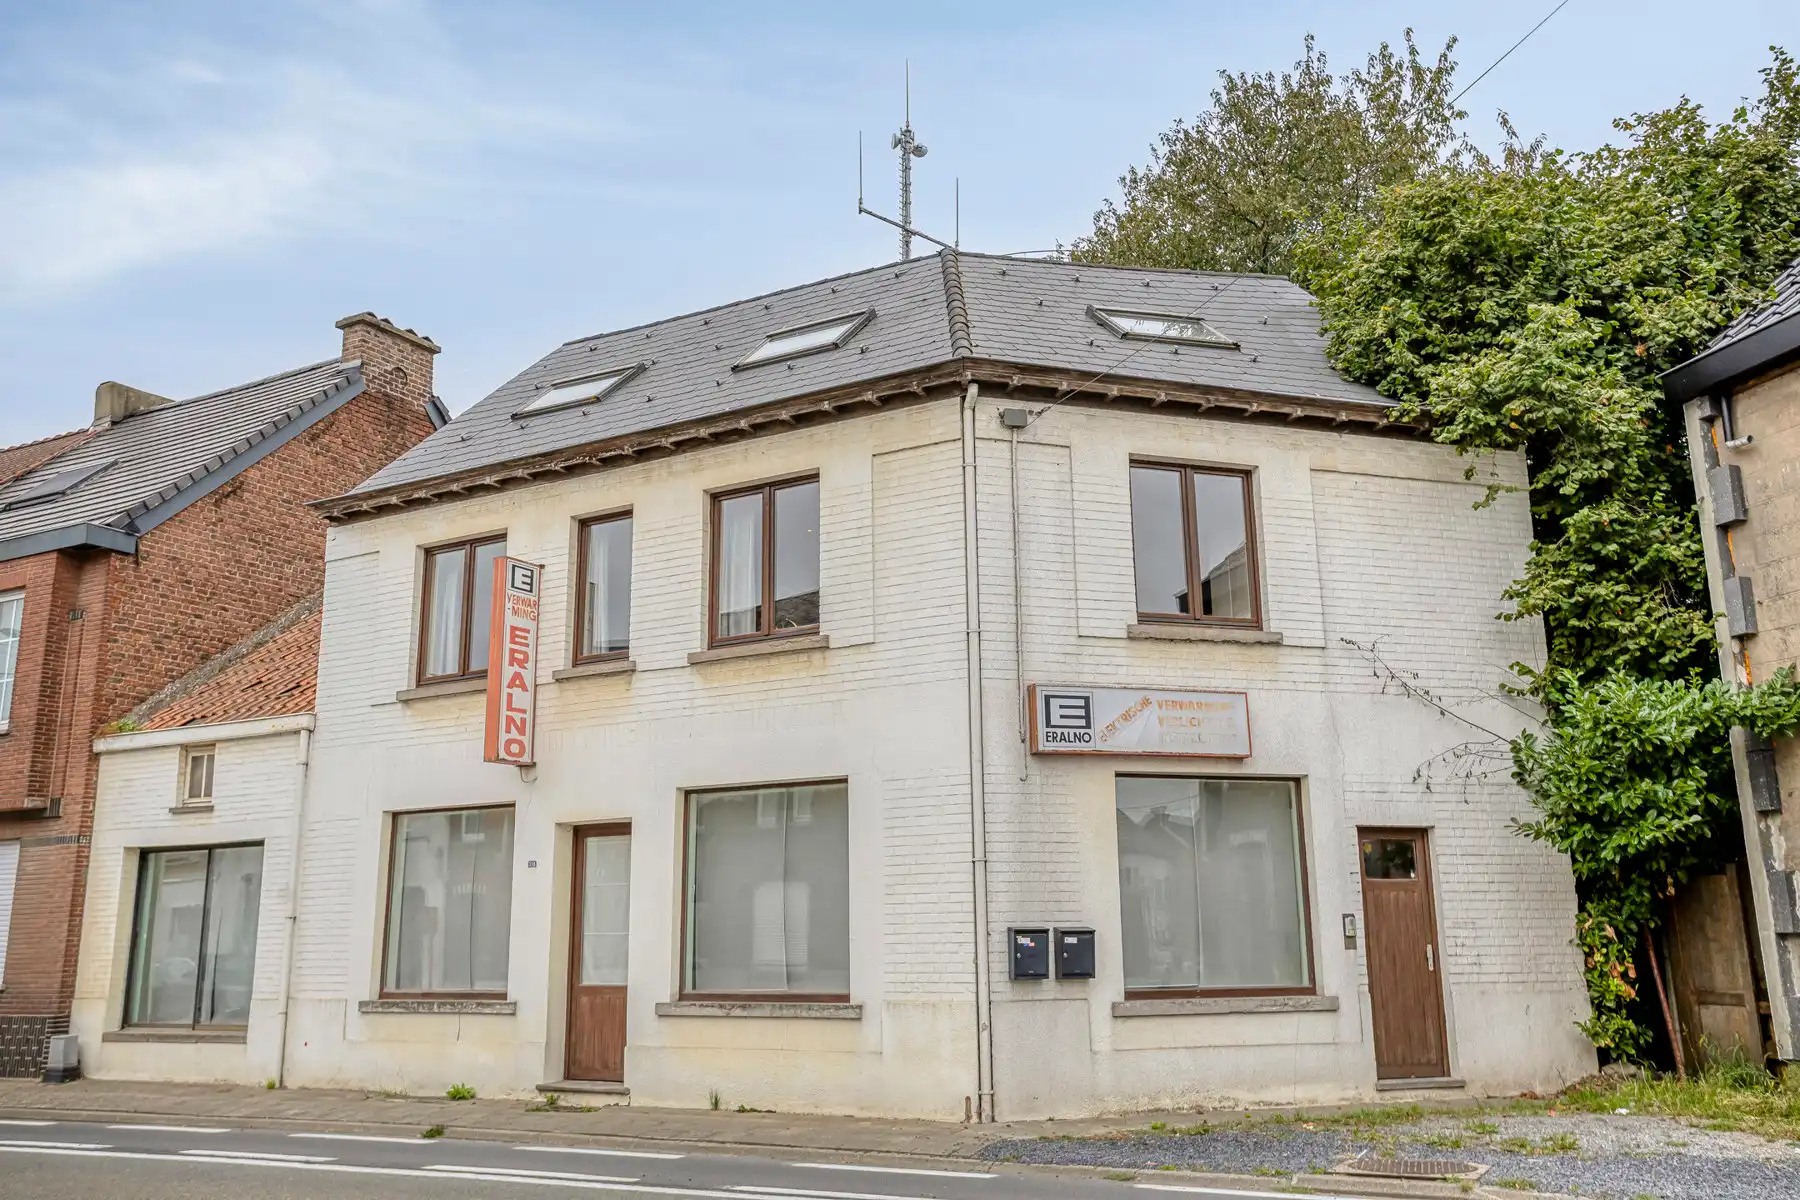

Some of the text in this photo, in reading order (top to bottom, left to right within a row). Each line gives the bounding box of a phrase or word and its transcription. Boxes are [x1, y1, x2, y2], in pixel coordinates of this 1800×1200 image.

[507, 592, 537, 610] VERWAR
[503, 625, 530, 759] ERALNO
[1046, 731, 1092, 744] ERALNO
